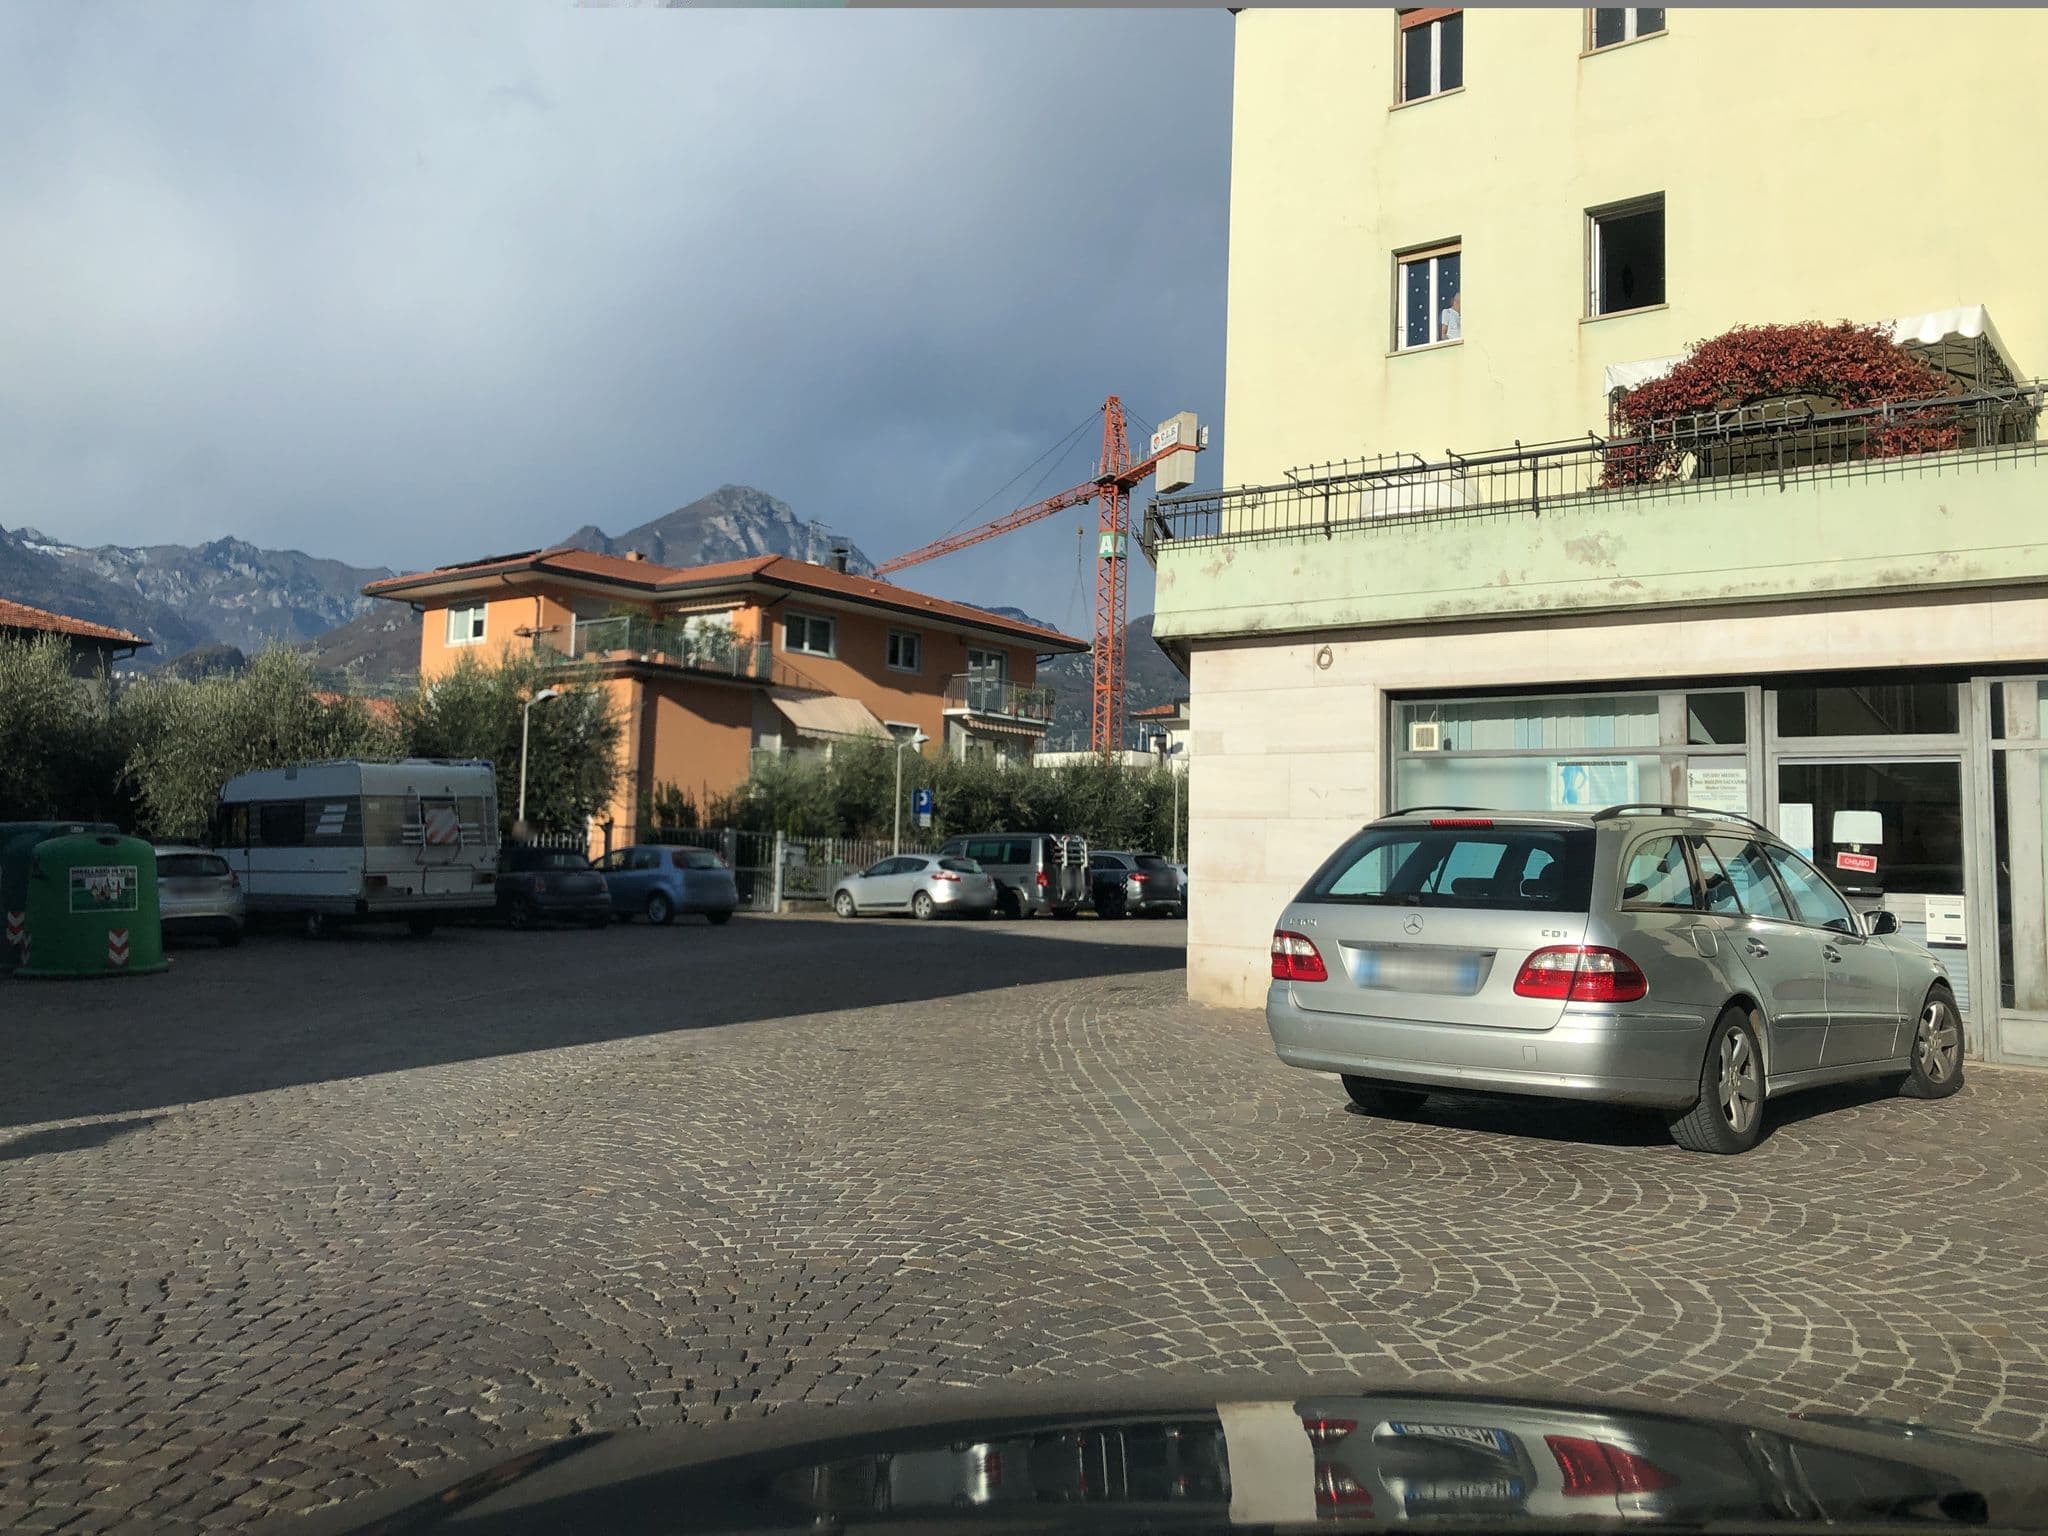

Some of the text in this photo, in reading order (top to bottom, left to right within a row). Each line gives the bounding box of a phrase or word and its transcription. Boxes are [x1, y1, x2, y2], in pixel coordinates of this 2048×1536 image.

[1099, 535, 1113, 553] A
[915, 791, 928, 812] P
[1541, 929, 1568, 938] CDI
